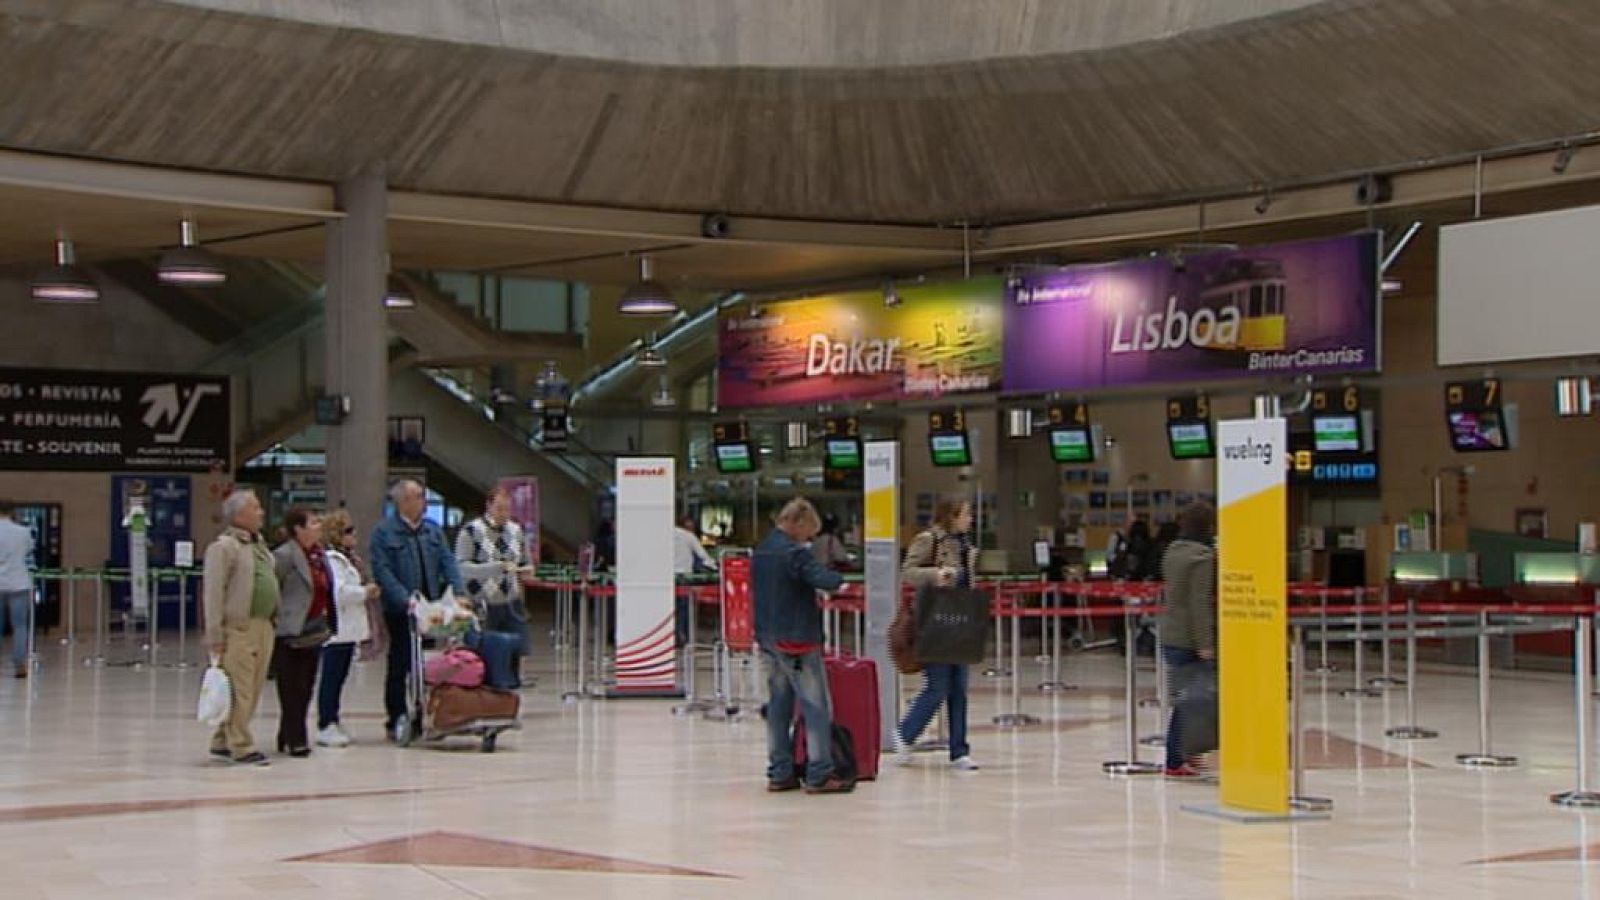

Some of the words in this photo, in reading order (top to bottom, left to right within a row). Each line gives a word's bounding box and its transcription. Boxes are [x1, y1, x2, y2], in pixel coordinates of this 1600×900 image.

[1111, 295, 1240, 353] Lisboa
[806, 331, 900, 376] Dakar
[41, 384, 122, 401] REVISTAS
[1344, 387, 1358, 411] 6
[1484, 380, 1497, 405] 7
[1074, 405, 1085, 424] 4
[1197, 396, 1207, 418] 5
[13, 410, 121, 428] PERFUMERÍA
[847, 417, 859, 436] 2
[953, 409, 964, 431] 3
[0, 439, 23, 454] TE
[37, 440, 122, 455] SOUVENIR
[174, 447, 215, 456] SUPERIOR
[1223, 436, 1272, 465] vueling
